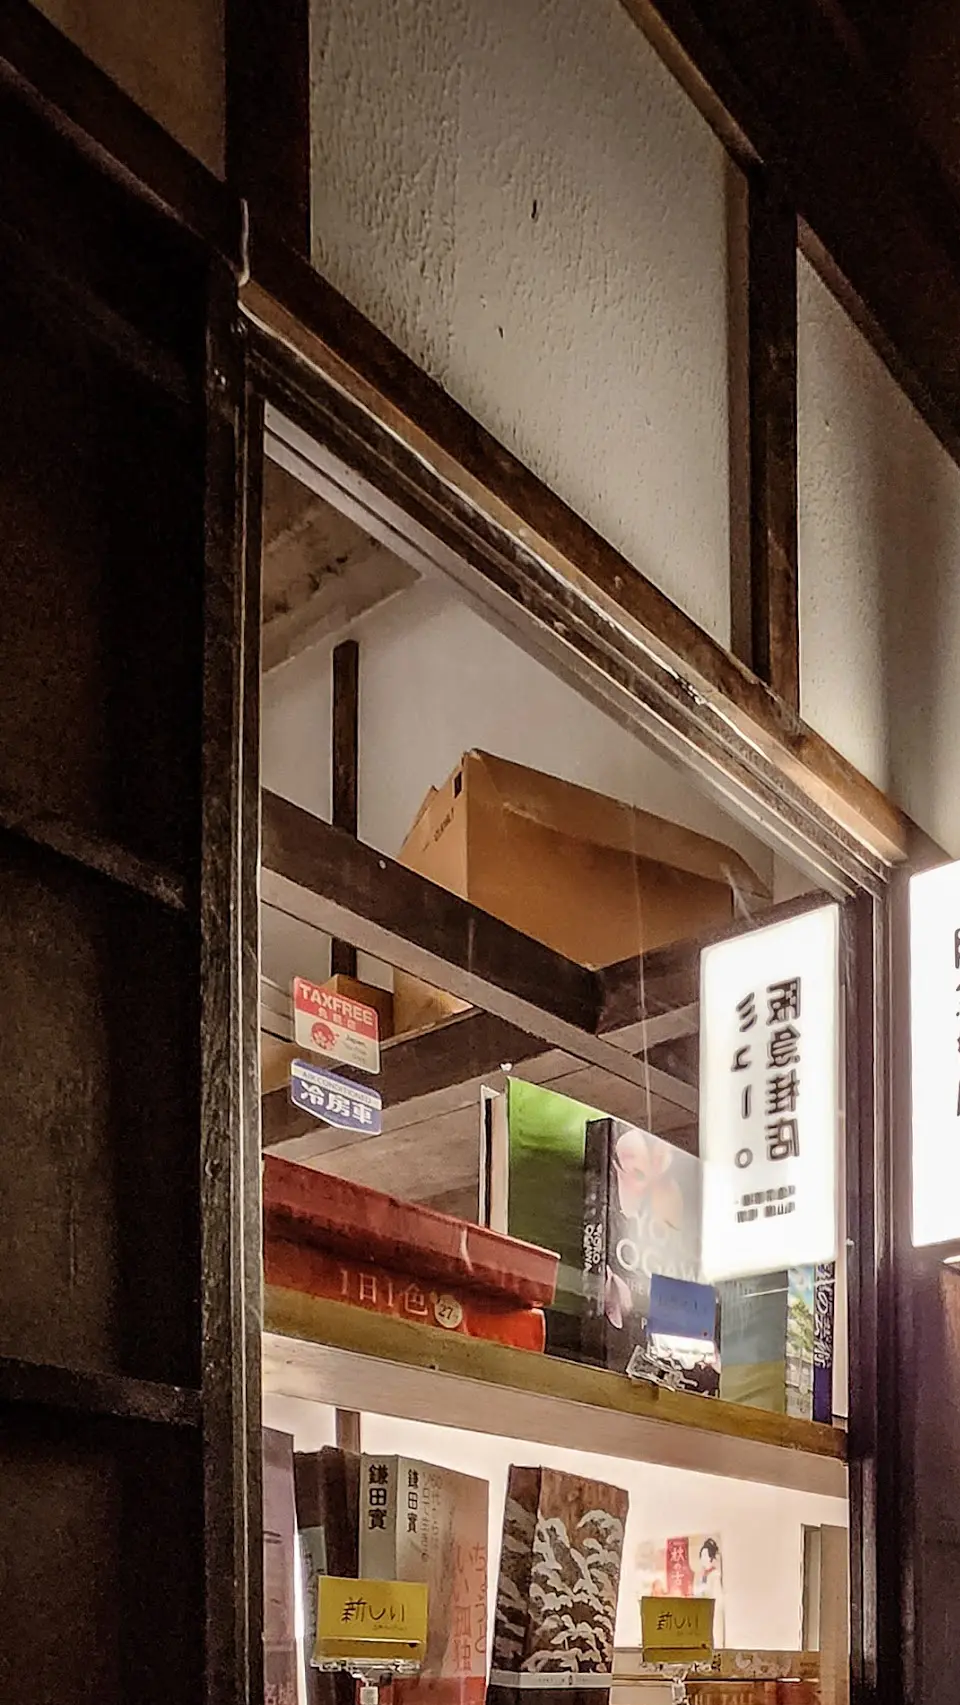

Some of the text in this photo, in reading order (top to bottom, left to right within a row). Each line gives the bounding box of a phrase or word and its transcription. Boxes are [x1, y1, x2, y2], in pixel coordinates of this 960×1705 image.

[301, 1080, 373, 1125] 冷房車
[368, 1463, 388, 1530] 鎌田實
[406, 1468, 419, 1534] 鎌田實
[341, 1596, 406, 1623] 新しい
